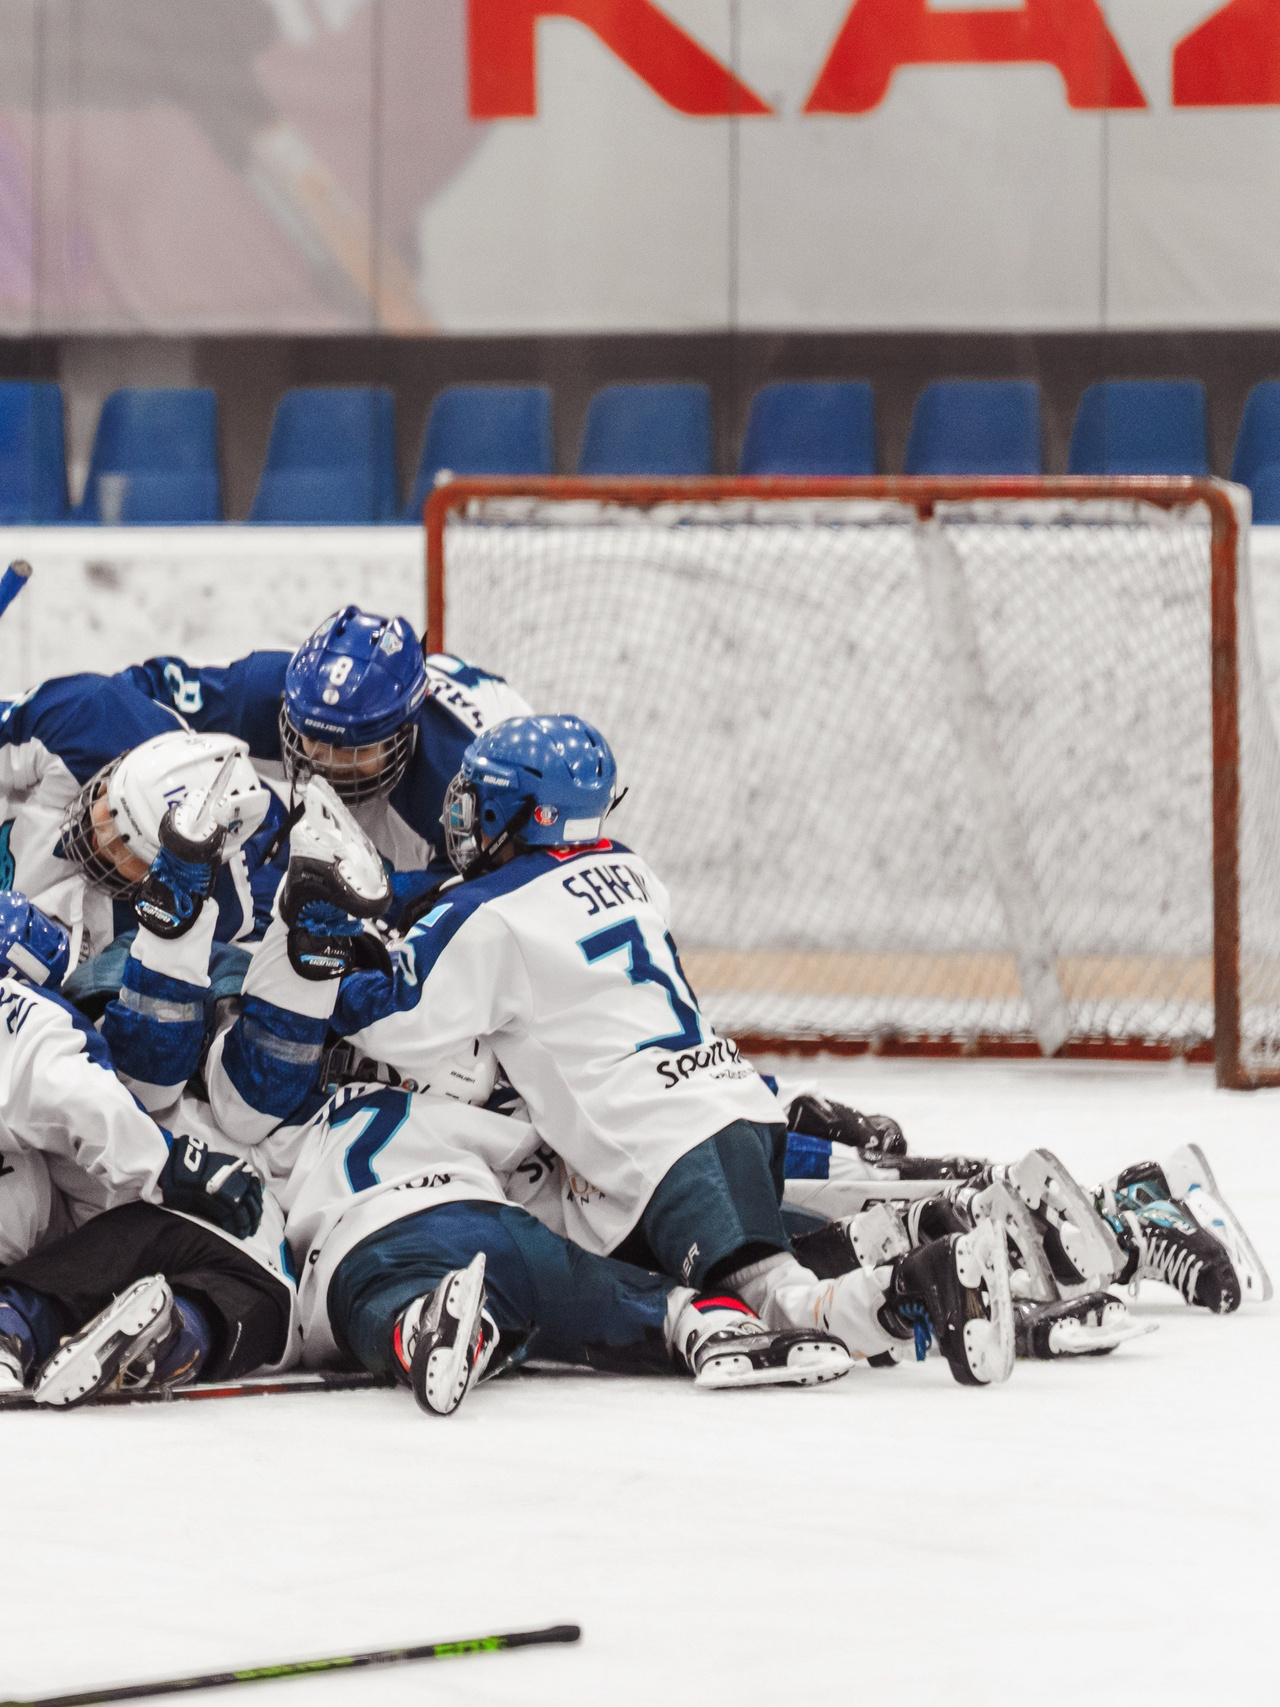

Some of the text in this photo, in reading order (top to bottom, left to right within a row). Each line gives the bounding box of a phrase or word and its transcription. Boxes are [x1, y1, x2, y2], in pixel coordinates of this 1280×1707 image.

[329, 655, 354, 687] 8
[304, 718, 346, 734] BAUER
[483, 774, 510, 788] BAUER
